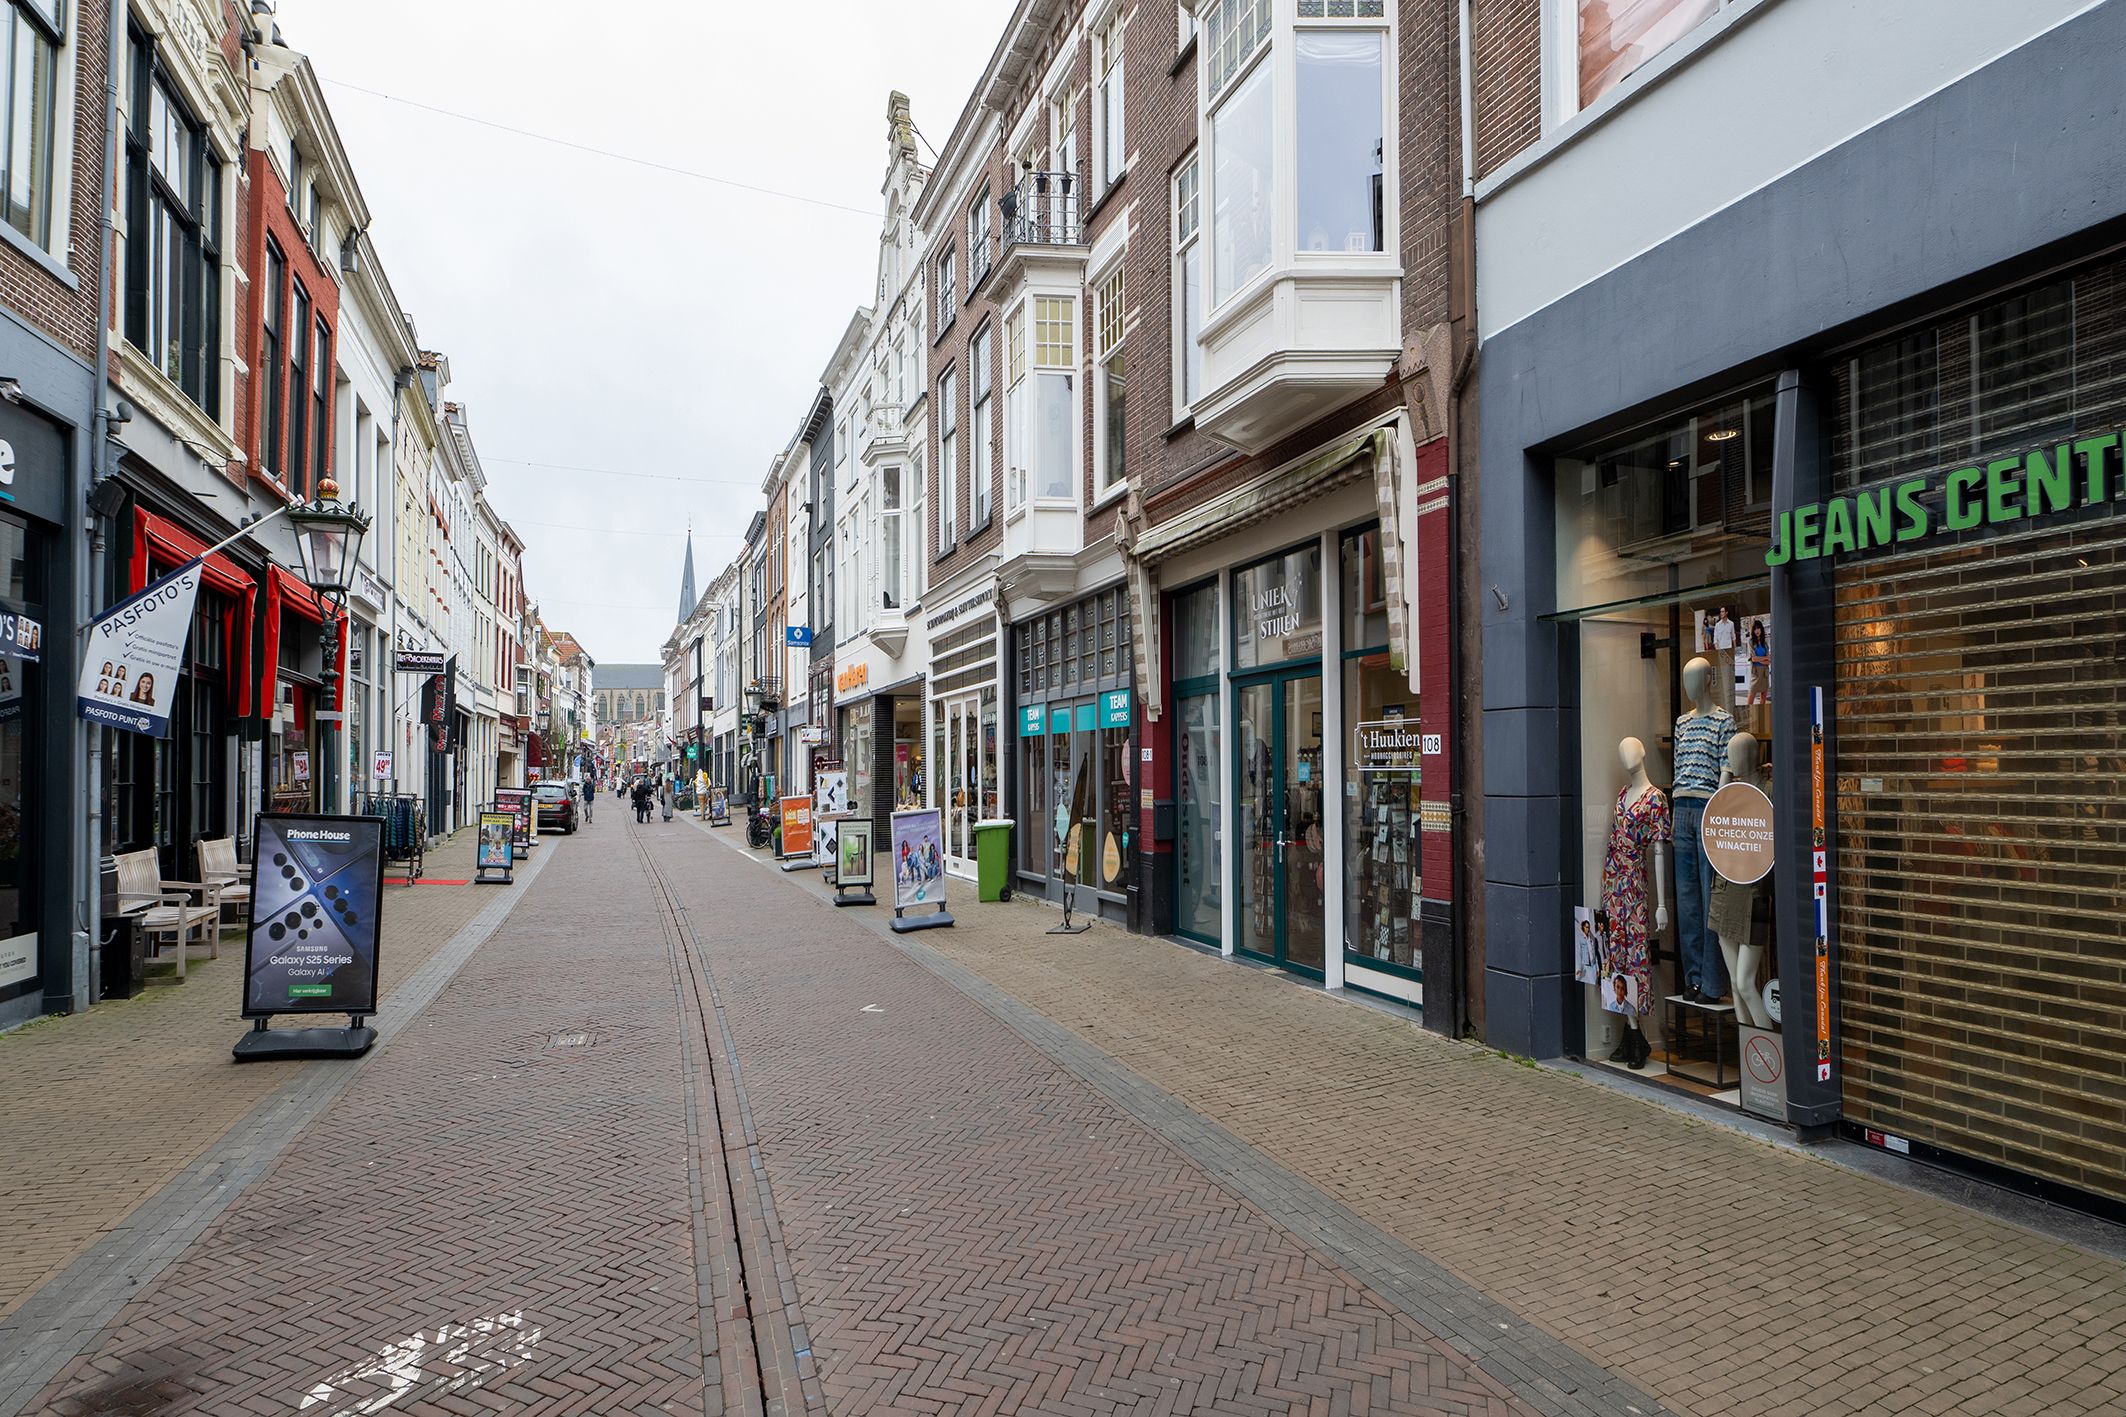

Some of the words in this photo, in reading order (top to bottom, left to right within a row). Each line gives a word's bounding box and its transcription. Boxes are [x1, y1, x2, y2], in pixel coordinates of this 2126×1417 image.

[1764, 478, 1928, 567] JEANS
[1945, 428, 2126, 532] CENT
[1252, 586, 1294, 612] UNIEK
[100, 575, 194, 638] PASFOTO'S
[1260, 612, 1300, 640] STIJLEN
[1109, 693, 1128, 710] TEAM
[84, 706, 119, 721] PASFOTO
[118, 714, 139, 726] PUNT
[1027, 709, 1040, 721] TEAM
[1110, 711, 1128, 723] KAPPERS
[1369, 728, 1420, 749] Huukien
[1423, 736, 1440, 752] 108
[1709, 815, 1730, 826] KOM
[1731, 817, 1766, 828] BINNEN
[287, 829, 319, 840] Phone
[319, 830, 351, 841] House
[1704, 827, 1716, 837] EN
[1718, 828, 1747, 839] CHECK
[1748, 830, 1774, 841] ONZE
[1715, 840, 1762, 853] WINACTIE!
[296, 945, 328, 953] SAMSUNG
[269, 955, 305, 966] Galaxy
[306, 955, 322, 965] S25
[323, 954, 353, 965] Series
[287, 968, 317, 978] Galaxy
